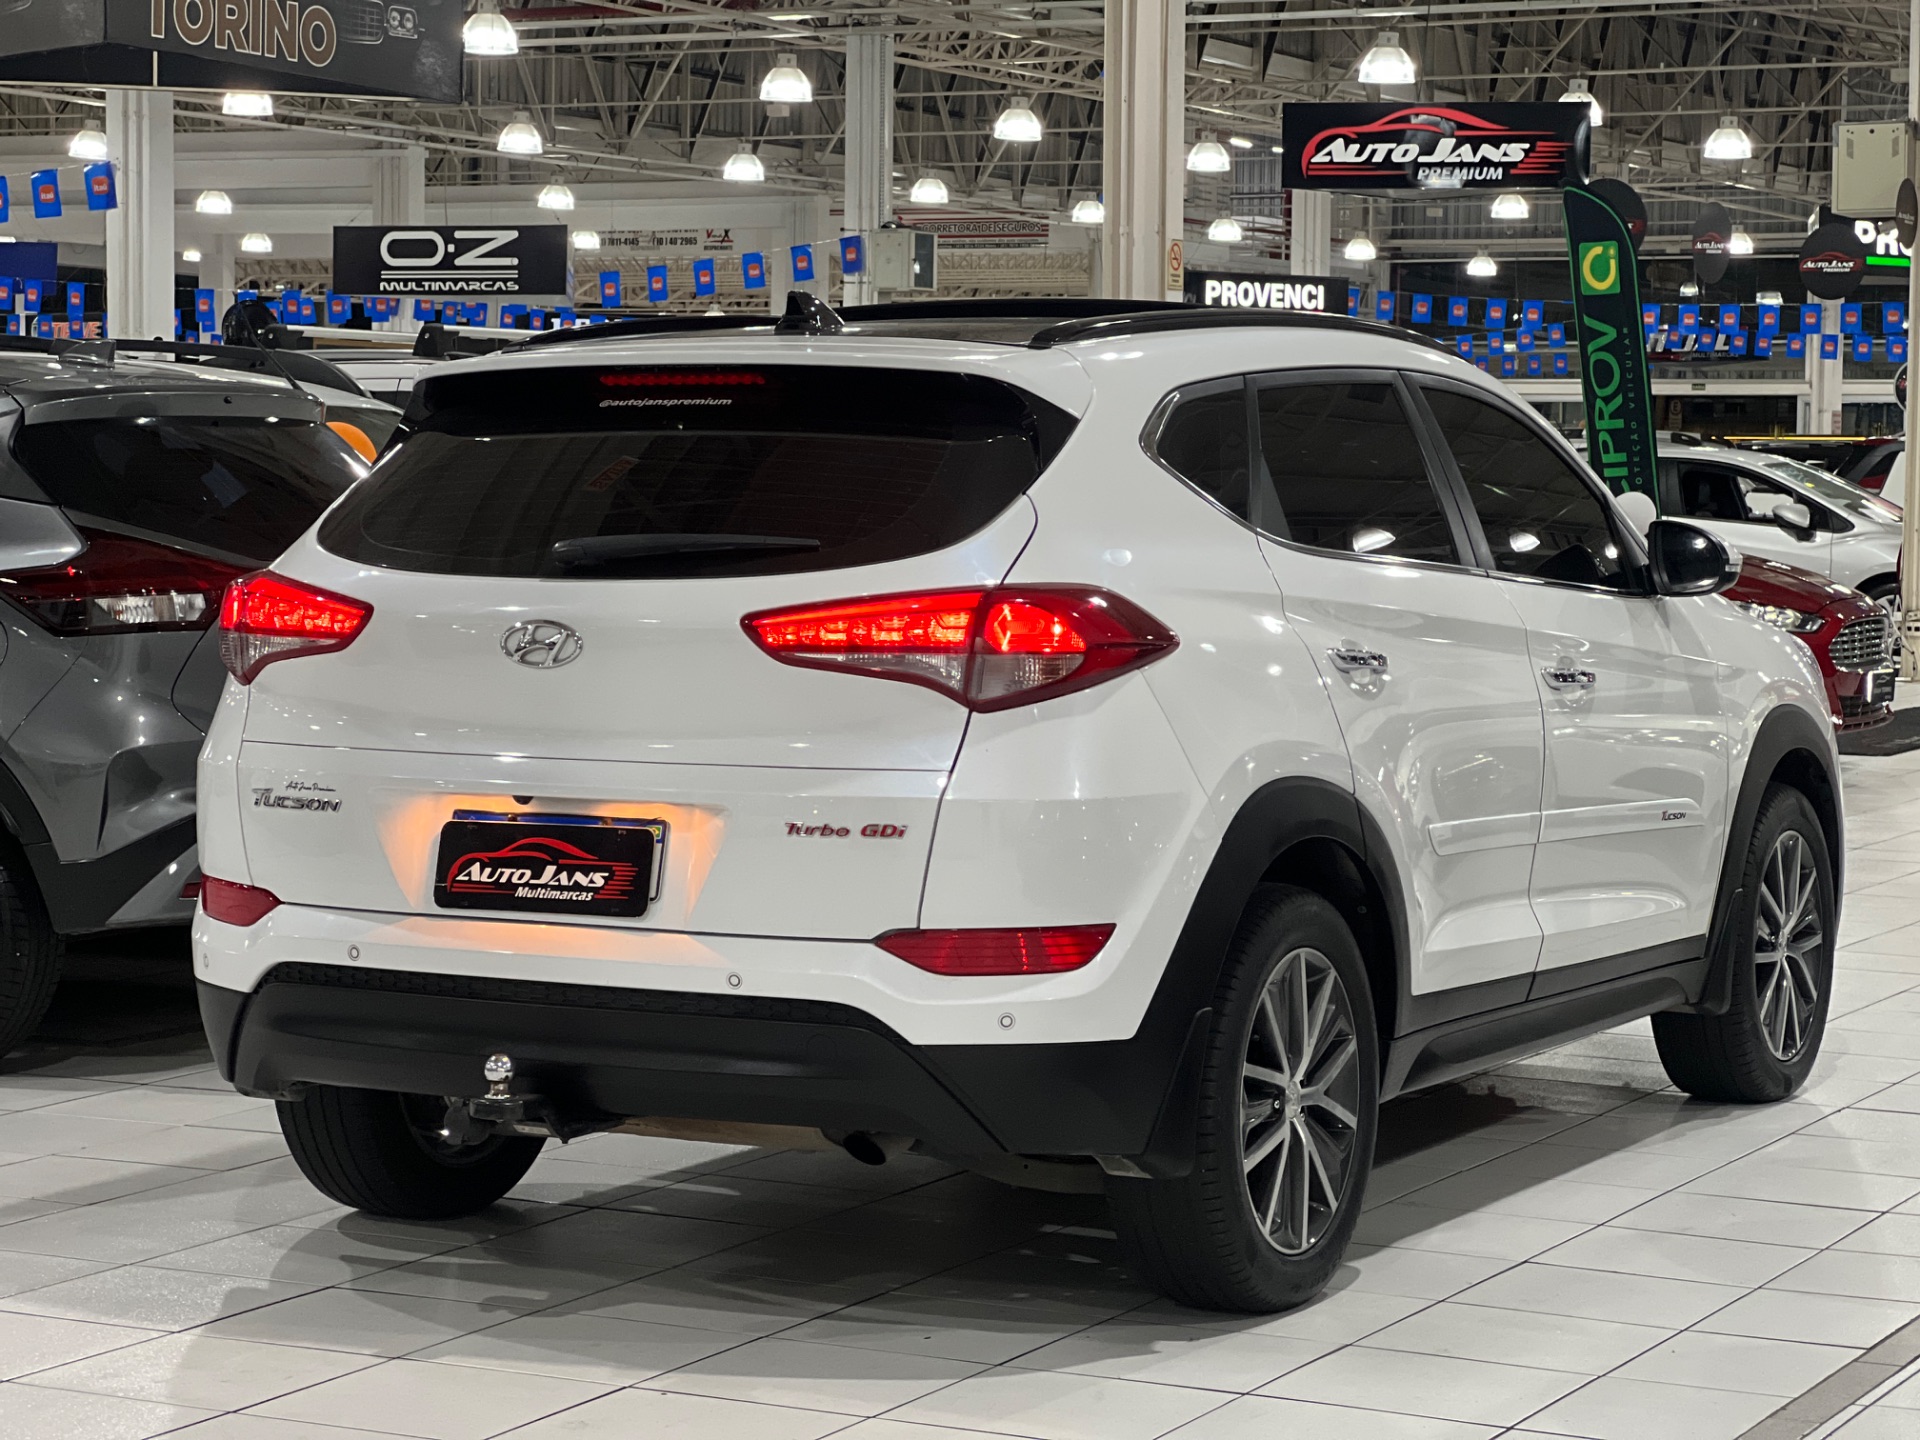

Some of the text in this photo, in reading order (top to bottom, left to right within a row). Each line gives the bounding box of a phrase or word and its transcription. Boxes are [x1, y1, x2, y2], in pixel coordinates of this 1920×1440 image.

[1417, 166, 1503, 180] PREMIUM
[996, 221, 1042, 233] SEGUROS
[379, 281, 520, 292] MULTIMARCAS
[1205, 279, 1325, 310] PROVENCI
[599, 397, 733, 407] @autojanspremium
[1622, 327, 1643, 492] OTEÇÃO VEICULAR
[785, 821, 908, 838] Turbo GDi
[514, 886, 594, 901] Multimarcas
